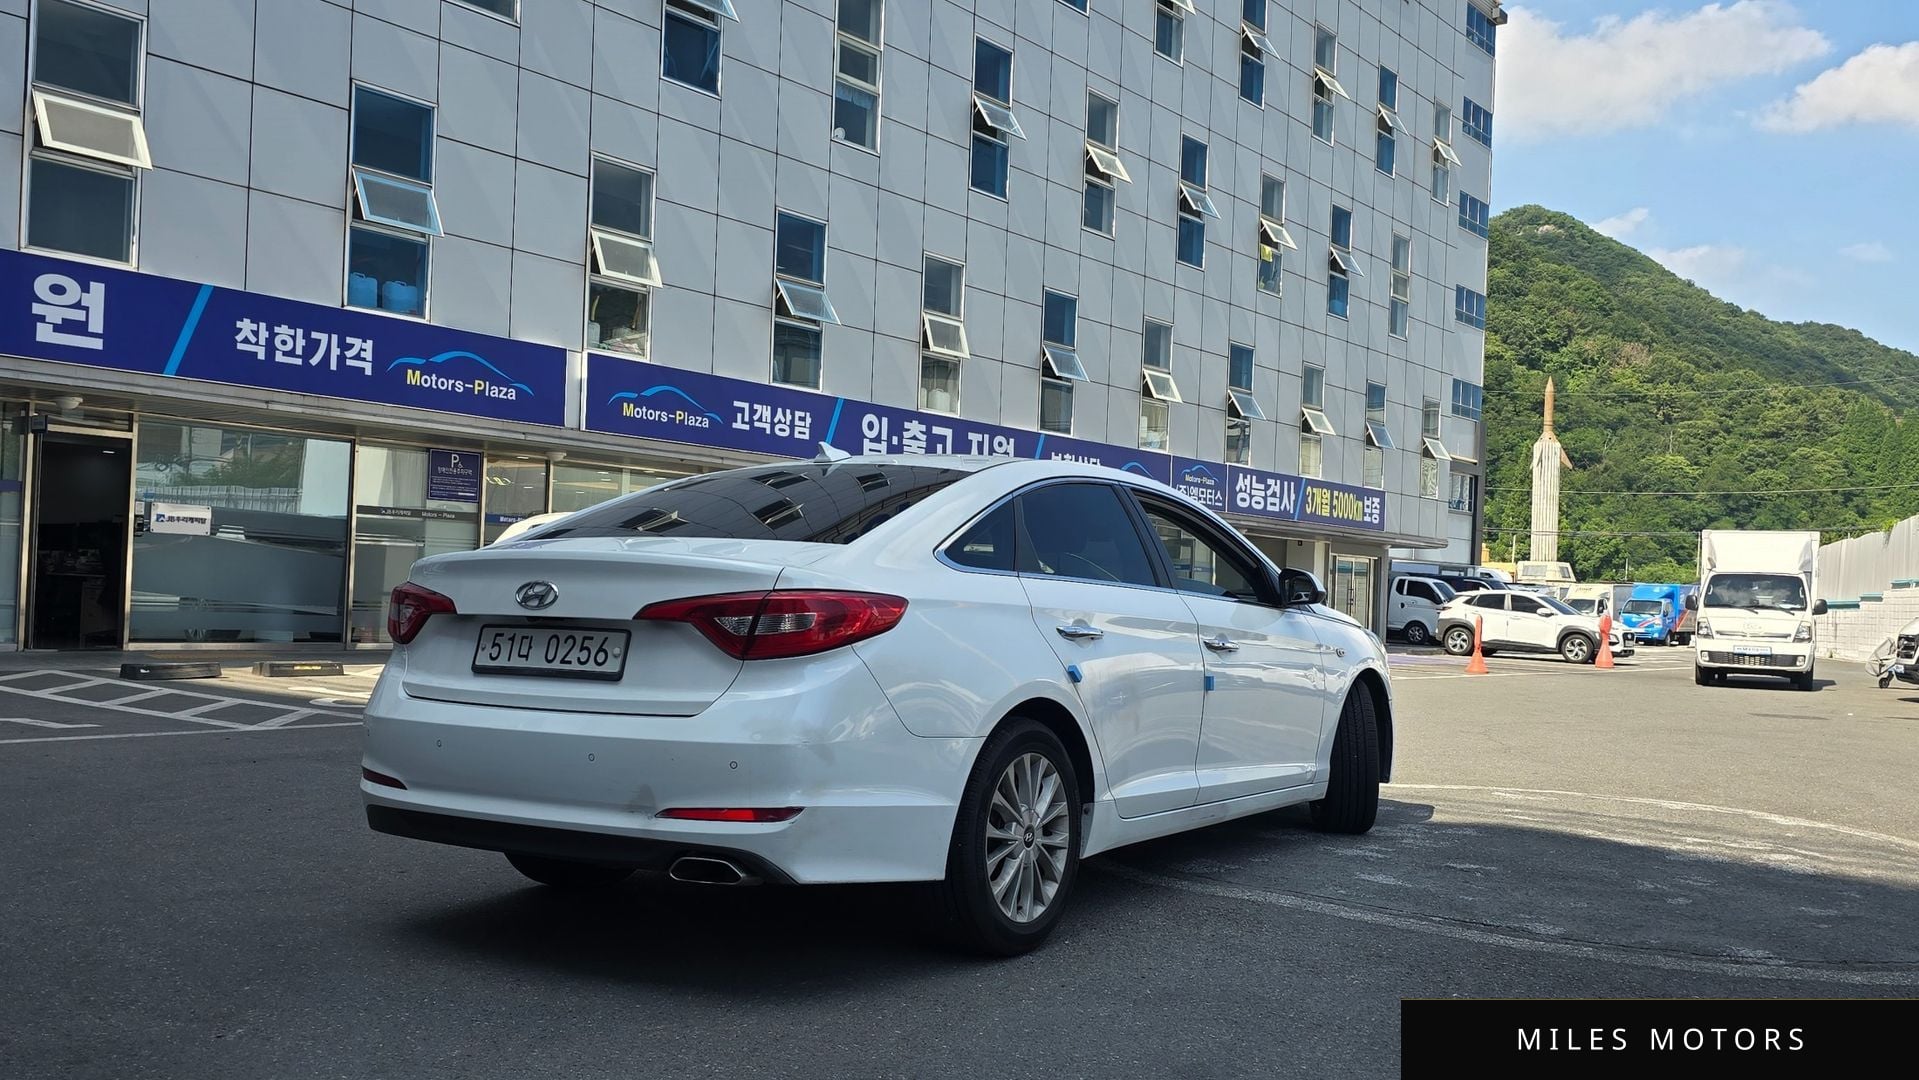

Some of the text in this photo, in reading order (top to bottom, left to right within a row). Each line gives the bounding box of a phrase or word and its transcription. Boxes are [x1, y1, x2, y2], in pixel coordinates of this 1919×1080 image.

[32, 273, 105, 350] 원
[235, 318, 374, 376] 착한가격
[407, 370, 516, 400] Motors-Plaza
[623, 403, 709, 428] Motors-Plaza
[732, 400, 812, 440] 고객상담
[451, 454, 459, 468] P
[1235, 473, 1296, 514] 성능검사
[1306, 486, 1330, 517] 3개월
[488, 632, 609, 667] 51다 0256
